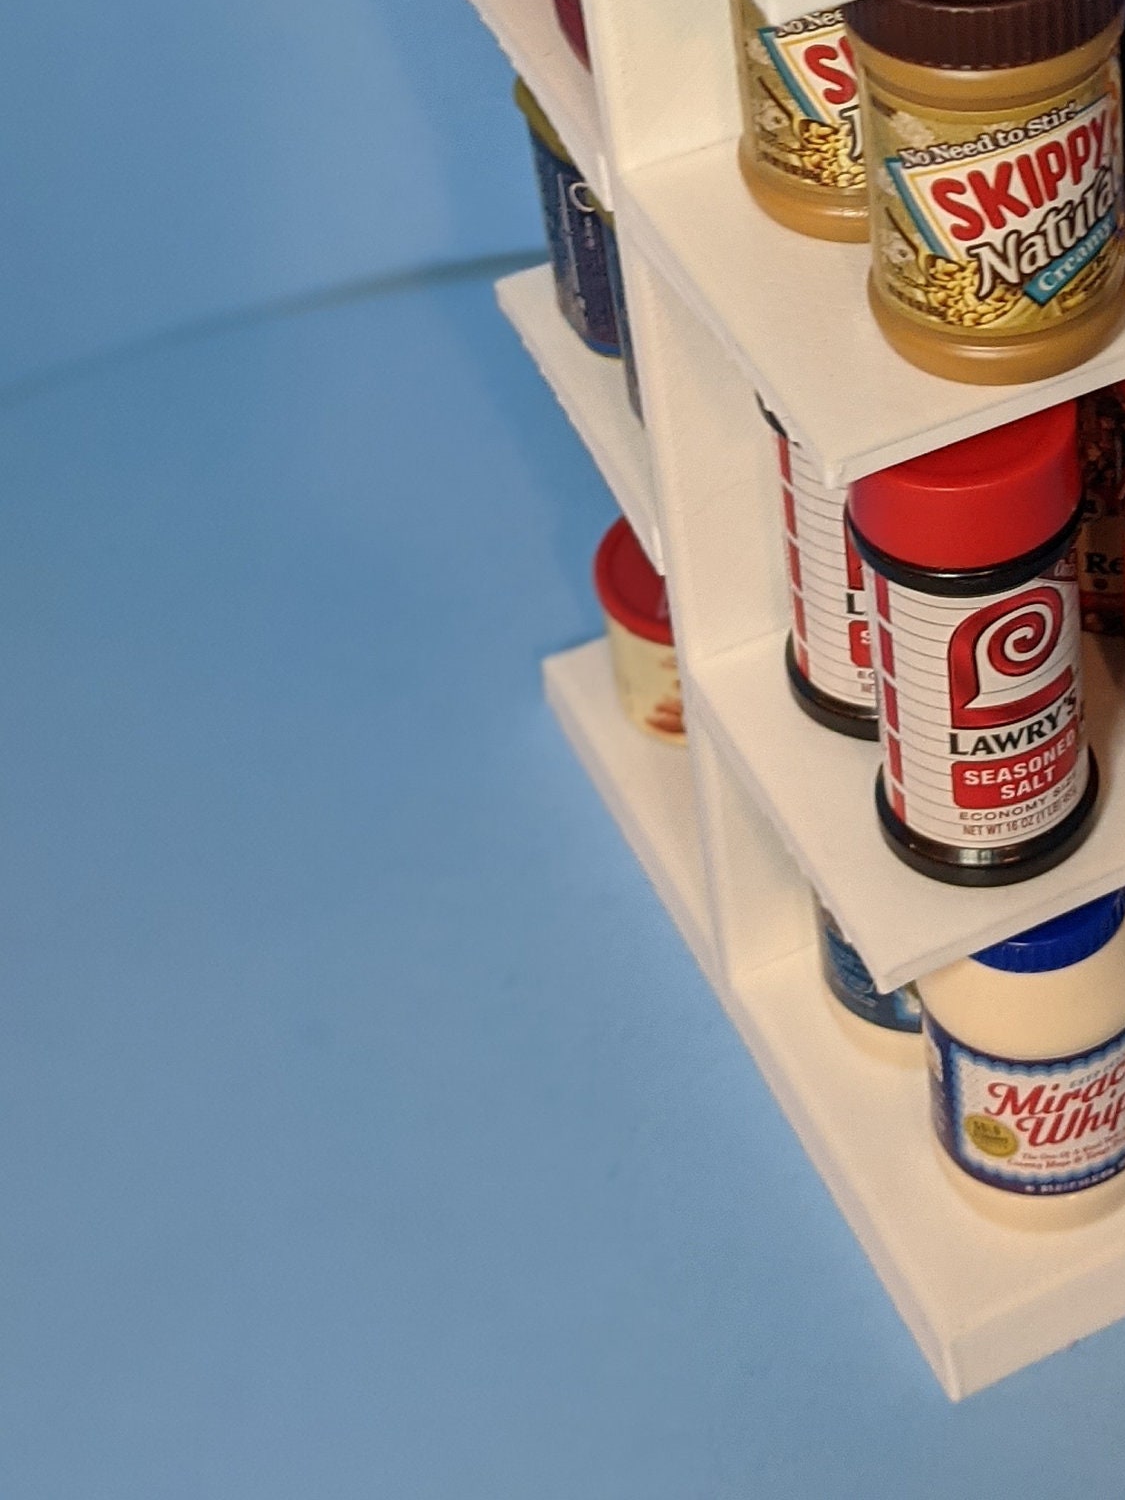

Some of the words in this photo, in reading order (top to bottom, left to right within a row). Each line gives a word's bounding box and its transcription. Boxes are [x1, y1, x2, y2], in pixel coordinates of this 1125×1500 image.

[804, 8, 845, 31] Nee
[900, 148, 931, 168] No
[934, 136, 996, 163] Need
[997, 126, 1025, 149] to
[931, 110, 1107, 241] SKIPPY
[966, 166, 1115, 300] Natura
[948, 688, 1078, 757] LAWRY'S
[963, 728, 1076, 786] SEASONED
[1001, 765, 1056, 800] SALT
[959, 796, 1048, 822] ECONOMY
